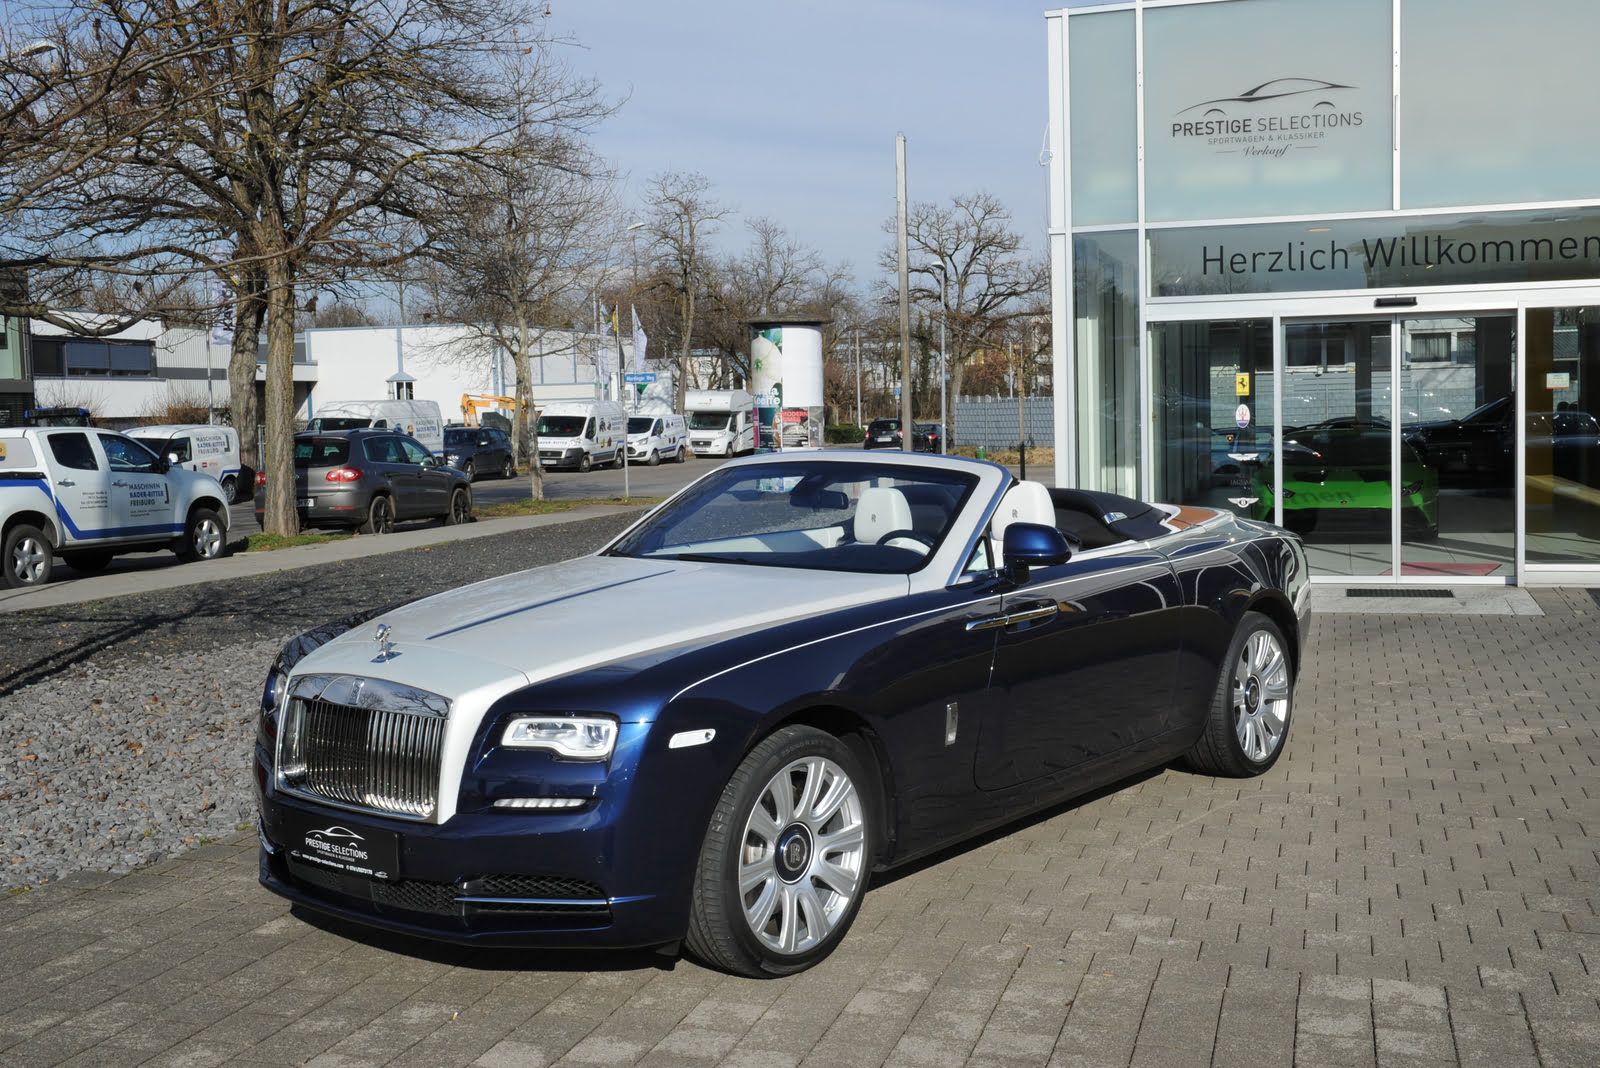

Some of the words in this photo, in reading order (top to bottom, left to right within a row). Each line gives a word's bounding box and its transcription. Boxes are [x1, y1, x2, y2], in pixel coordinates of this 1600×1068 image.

[1172, 119, 1252, 137] PRESTIGE
[1257, 111, 1363, 132] SELECTIONS
[1207, 135, 1265, 145] SPORTWAGEN
[1277, 131, 1325, 141] KLASSIKER
[1243, 144, 1292, 158] Verkauf
[1202, 240, 1349, 275] Herzlich
[1362, 232, 1600, 268] Willkommen
[129, 490, 164, 498] BADER-RITTER
[130, 499, 155, 507] FREIBURG
[305, 837, 331, 851] PRESTIGE
[331, 844, 368, 860] SELECTIONS
